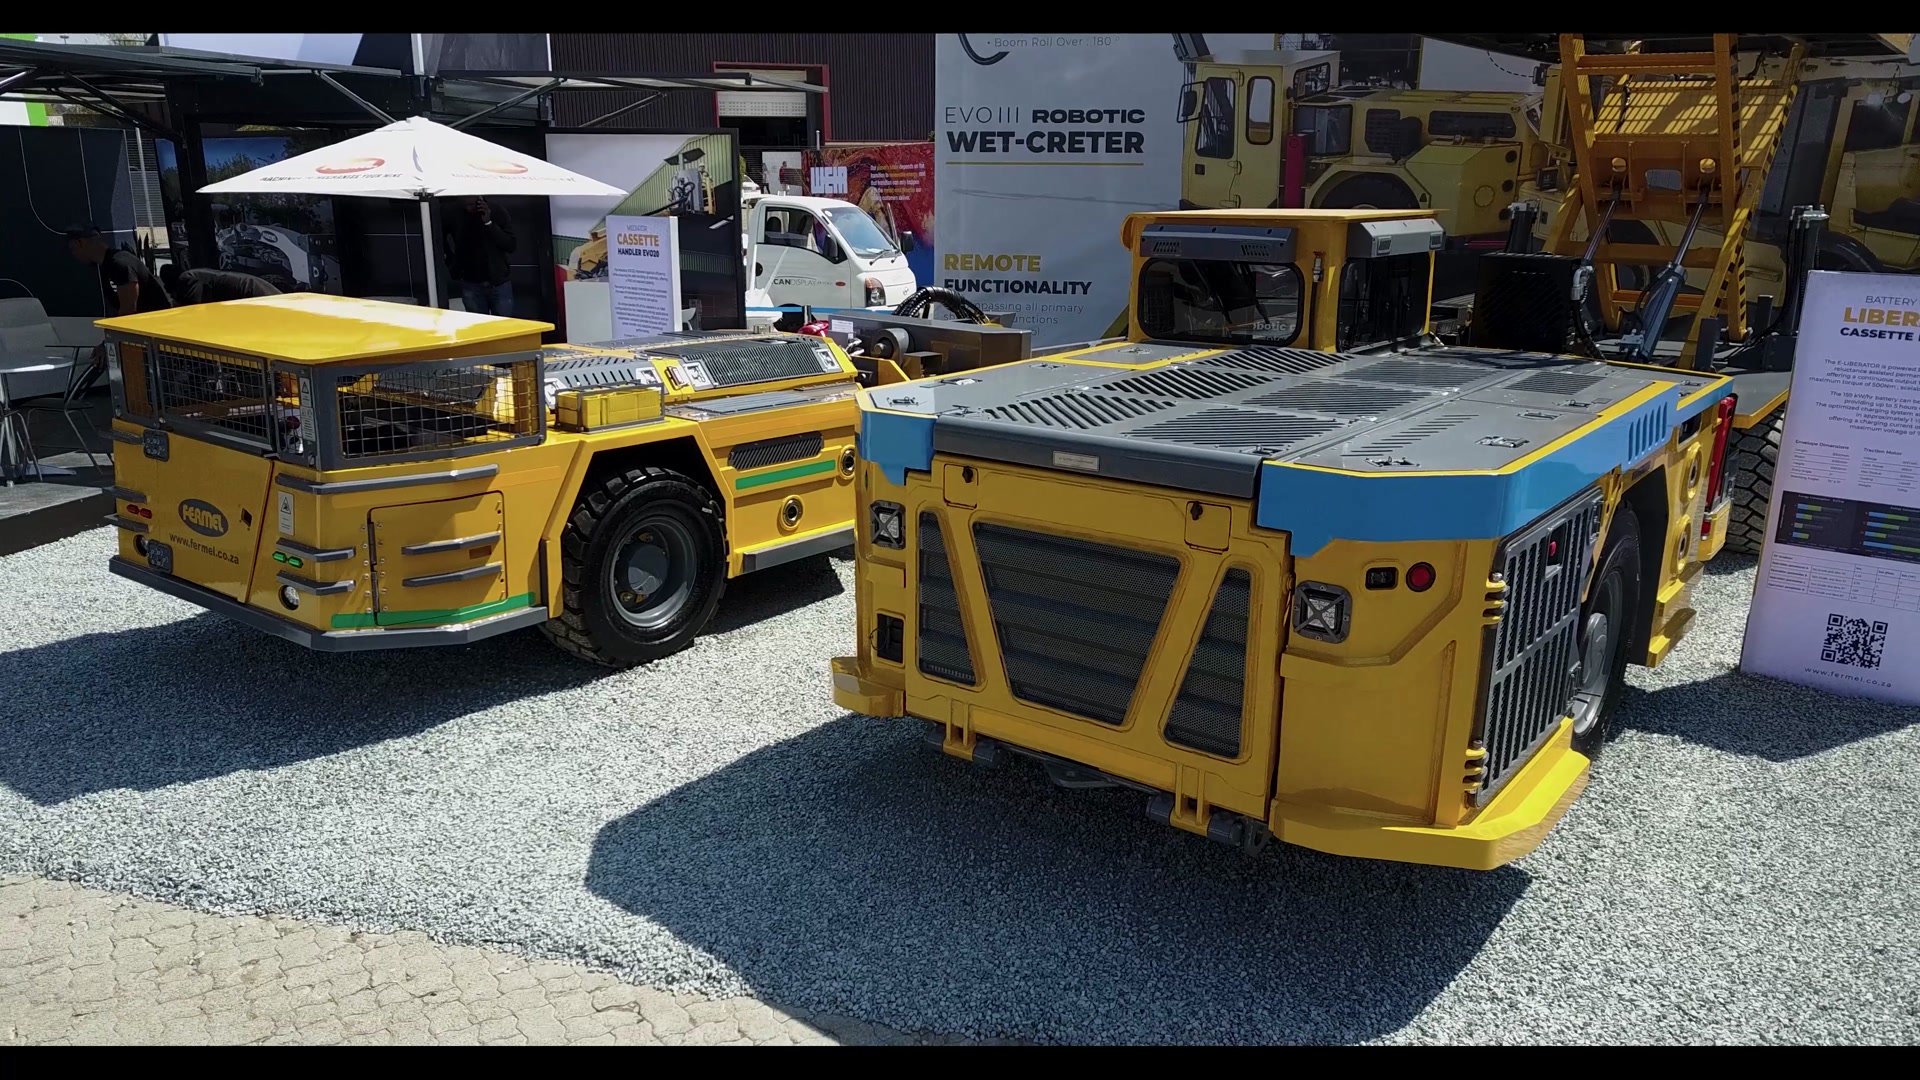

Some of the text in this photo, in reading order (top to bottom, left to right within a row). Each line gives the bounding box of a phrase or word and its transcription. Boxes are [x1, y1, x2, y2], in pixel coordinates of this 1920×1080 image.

[994, 38, 1028, 47] Boom
[1032, 37, 1053, 47] Roll
[1056, 37, 1083, 46] Over
[1092, 36, 1112, 46] 180
[1032, 109, 1146, 124] ROBOTIC
[946, 130, 1145, 154] WET-CRETER
[617, 233, 659, 247] CASSETTE
[618, 248, 660, 258] HANDLER EVO20
[944, 253, 1042, 272] REMOTE
[944, 279, 1093, 295] FUNCTIONALITY
[1865, 295, 1918, 307] BATTERY
[1026, 301, 1038, 311] all
[1041, 302, 1084, 314] primary
[1012, 316, 1059, 325] unctions
[1843, 307, 1920, 327] LIBER
[1840, 327, 1914, 341] CASSETTE
[1834, 366, 1868, 375] reluctance
[1869, 369, 1895, 377] assisted
[1888, 365, 1917, 373] powered
[1809, 376, 1841, 385] maximum
[1842, 379, 1863, 387] torque
[1826, 372, 1851, 380] offering
[1857, 375, 1894, 383] continuous
[1844, 399, 1874, 407] providing
[1875, 395, 1898, 403] battery
[1828, 403, 1860, 411] optimized
[1860, 406, 1889, 415] charging
[1859, 419, 1888, 427] charging
[1863, 413, 1910, 423] approximately
[1849, 424, 1882, 432] maximum
[1883, 427, 1908, 435] voltage
[182, 503, 225, 533] FERMEL
[169, 532, 240, 565] www.fermel.co.za
[1804, 667, 1892, 688] www.fermel.co.za
